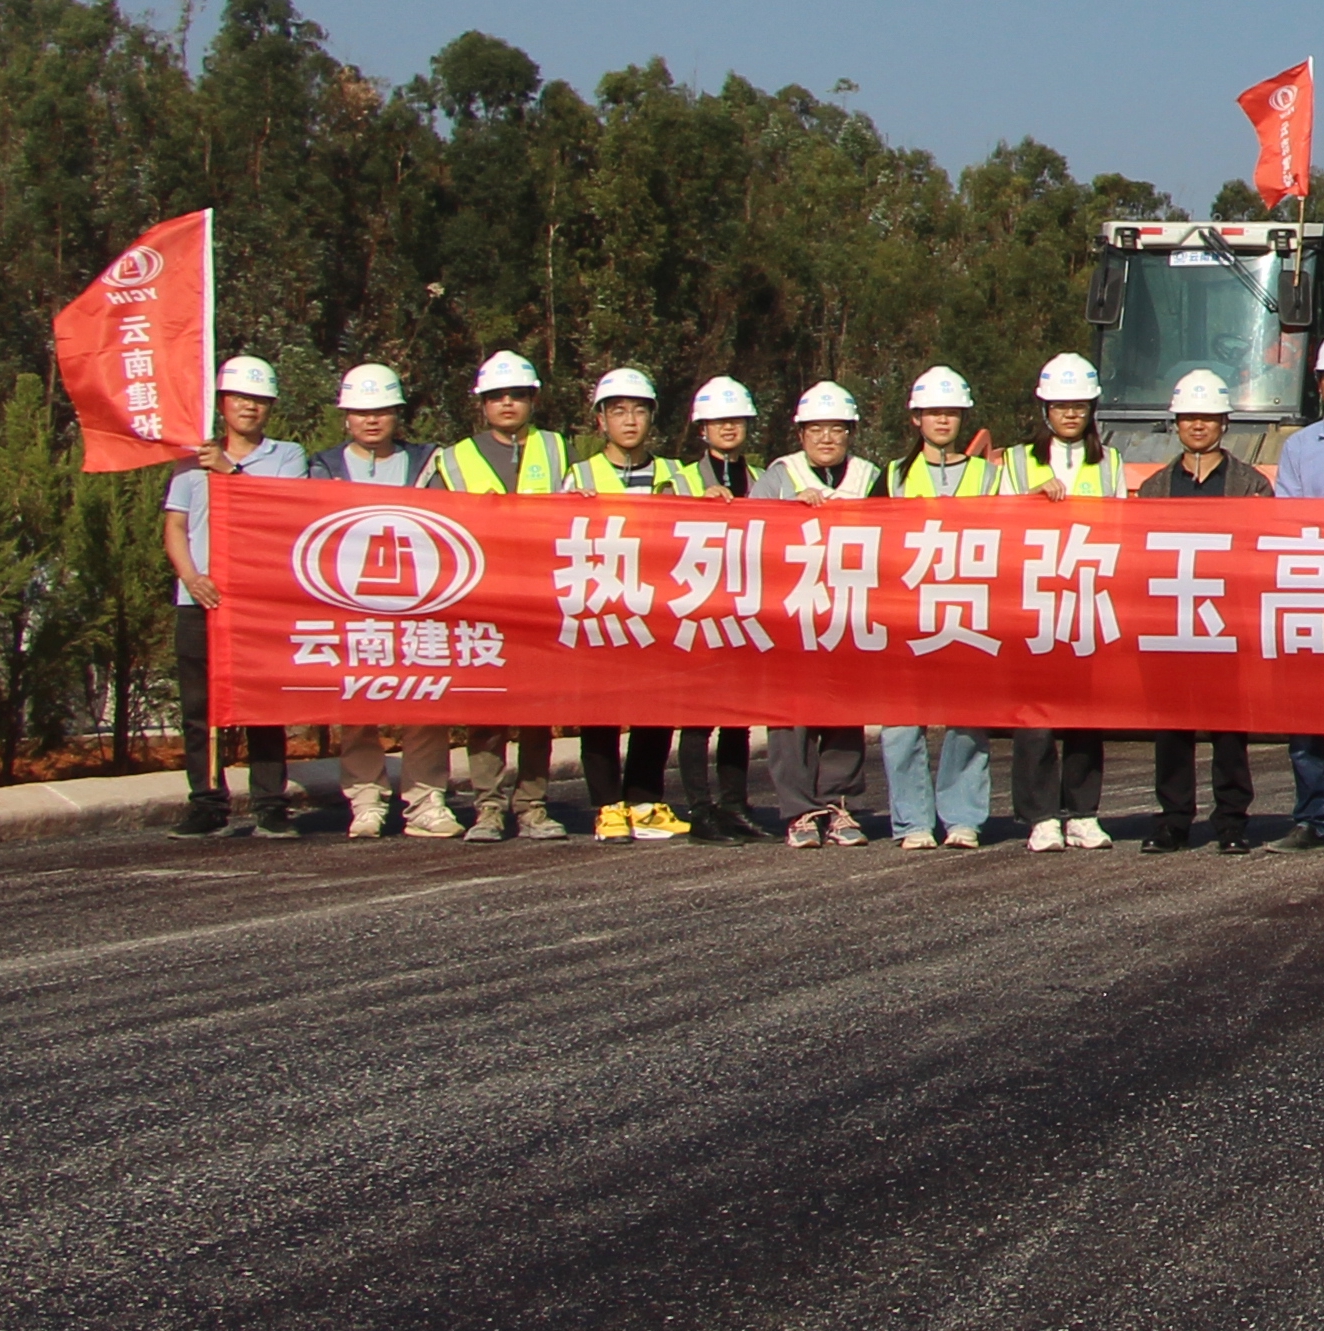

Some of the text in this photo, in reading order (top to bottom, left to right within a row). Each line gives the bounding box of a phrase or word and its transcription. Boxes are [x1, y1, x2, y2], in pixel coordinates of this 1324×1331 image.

[289, 619, 506, 668] 云南建投
[340, 675, 452, 701] YCIH
